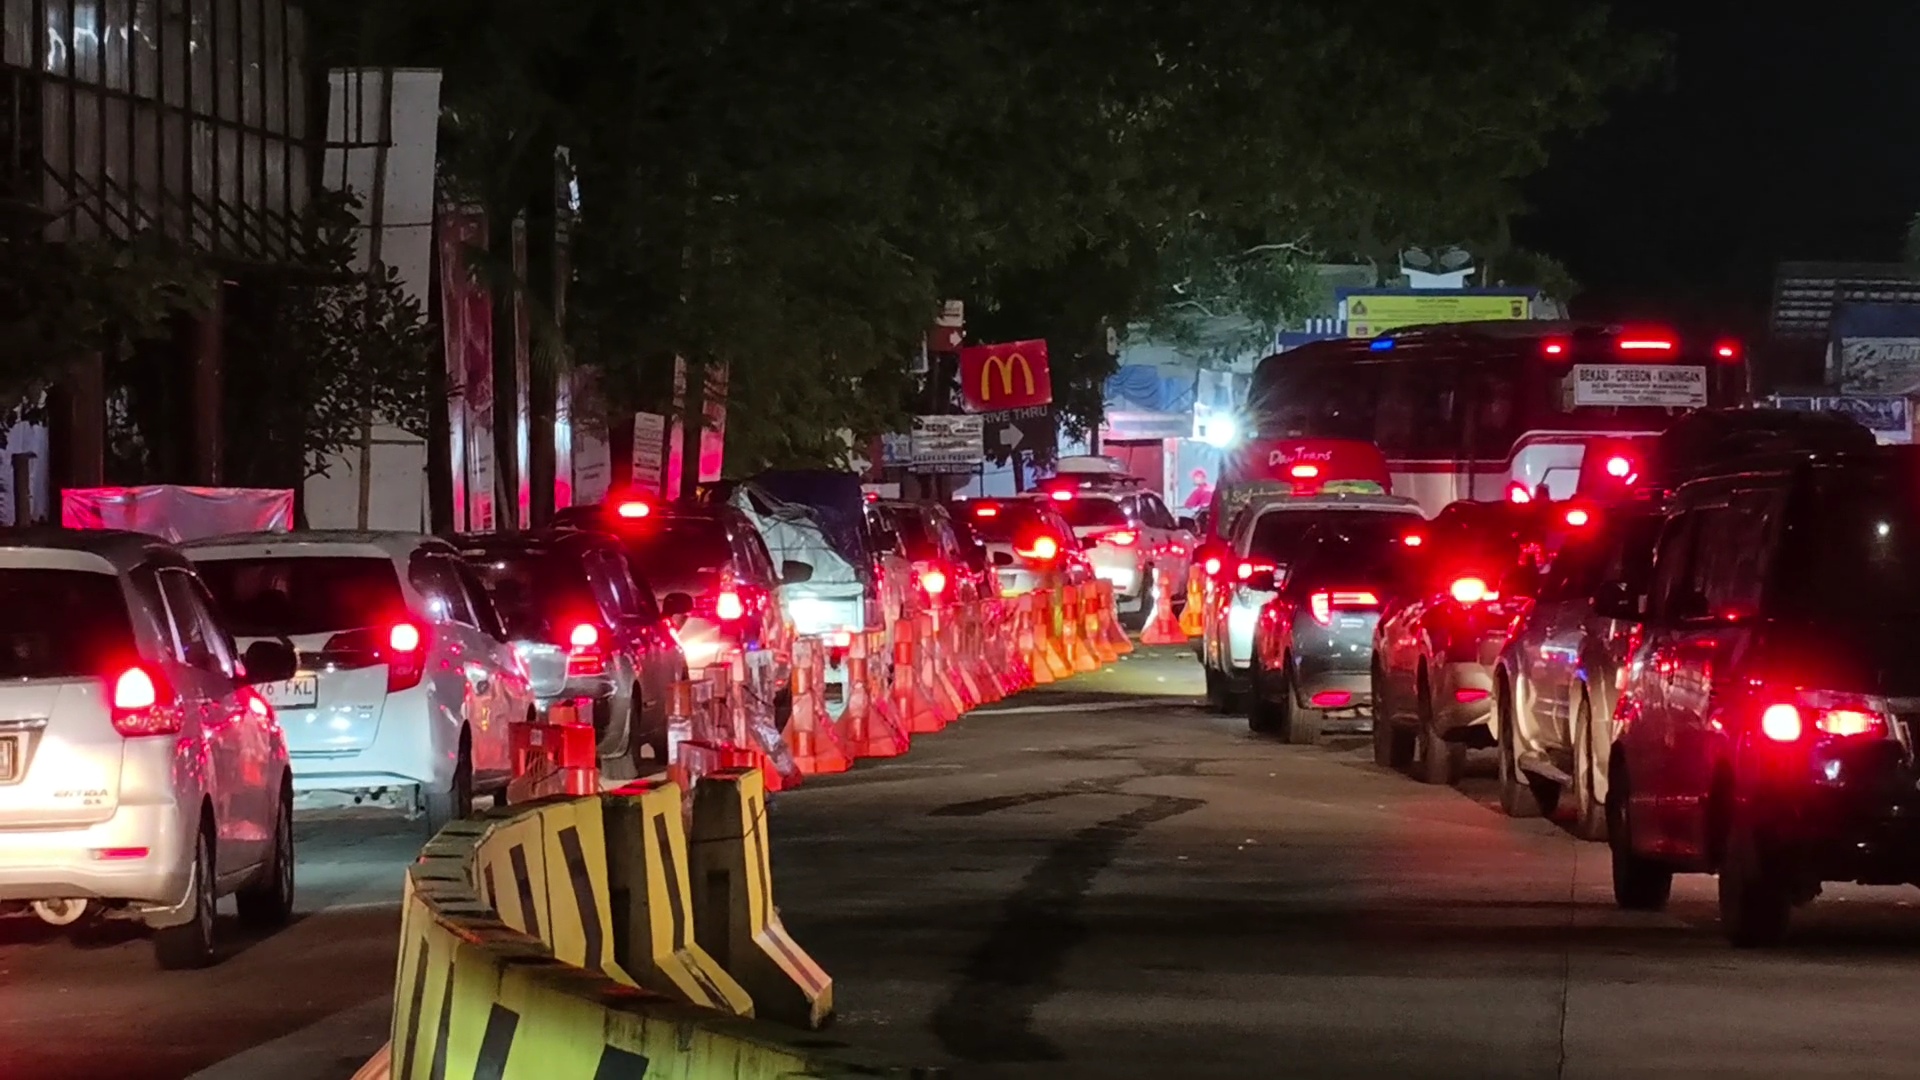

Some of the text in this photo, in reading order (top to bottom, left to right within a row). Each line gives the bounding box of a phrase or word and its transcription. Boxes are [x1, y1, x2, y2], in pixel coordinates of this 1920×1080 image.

[1579, 369, 1609, 382] BEKASI
[1615, 369, 1652, 382] CIREBON
[1658, 370, 1701, 382] KUNINGAN
[983, 405, 1048, 424] RIVE THRU
